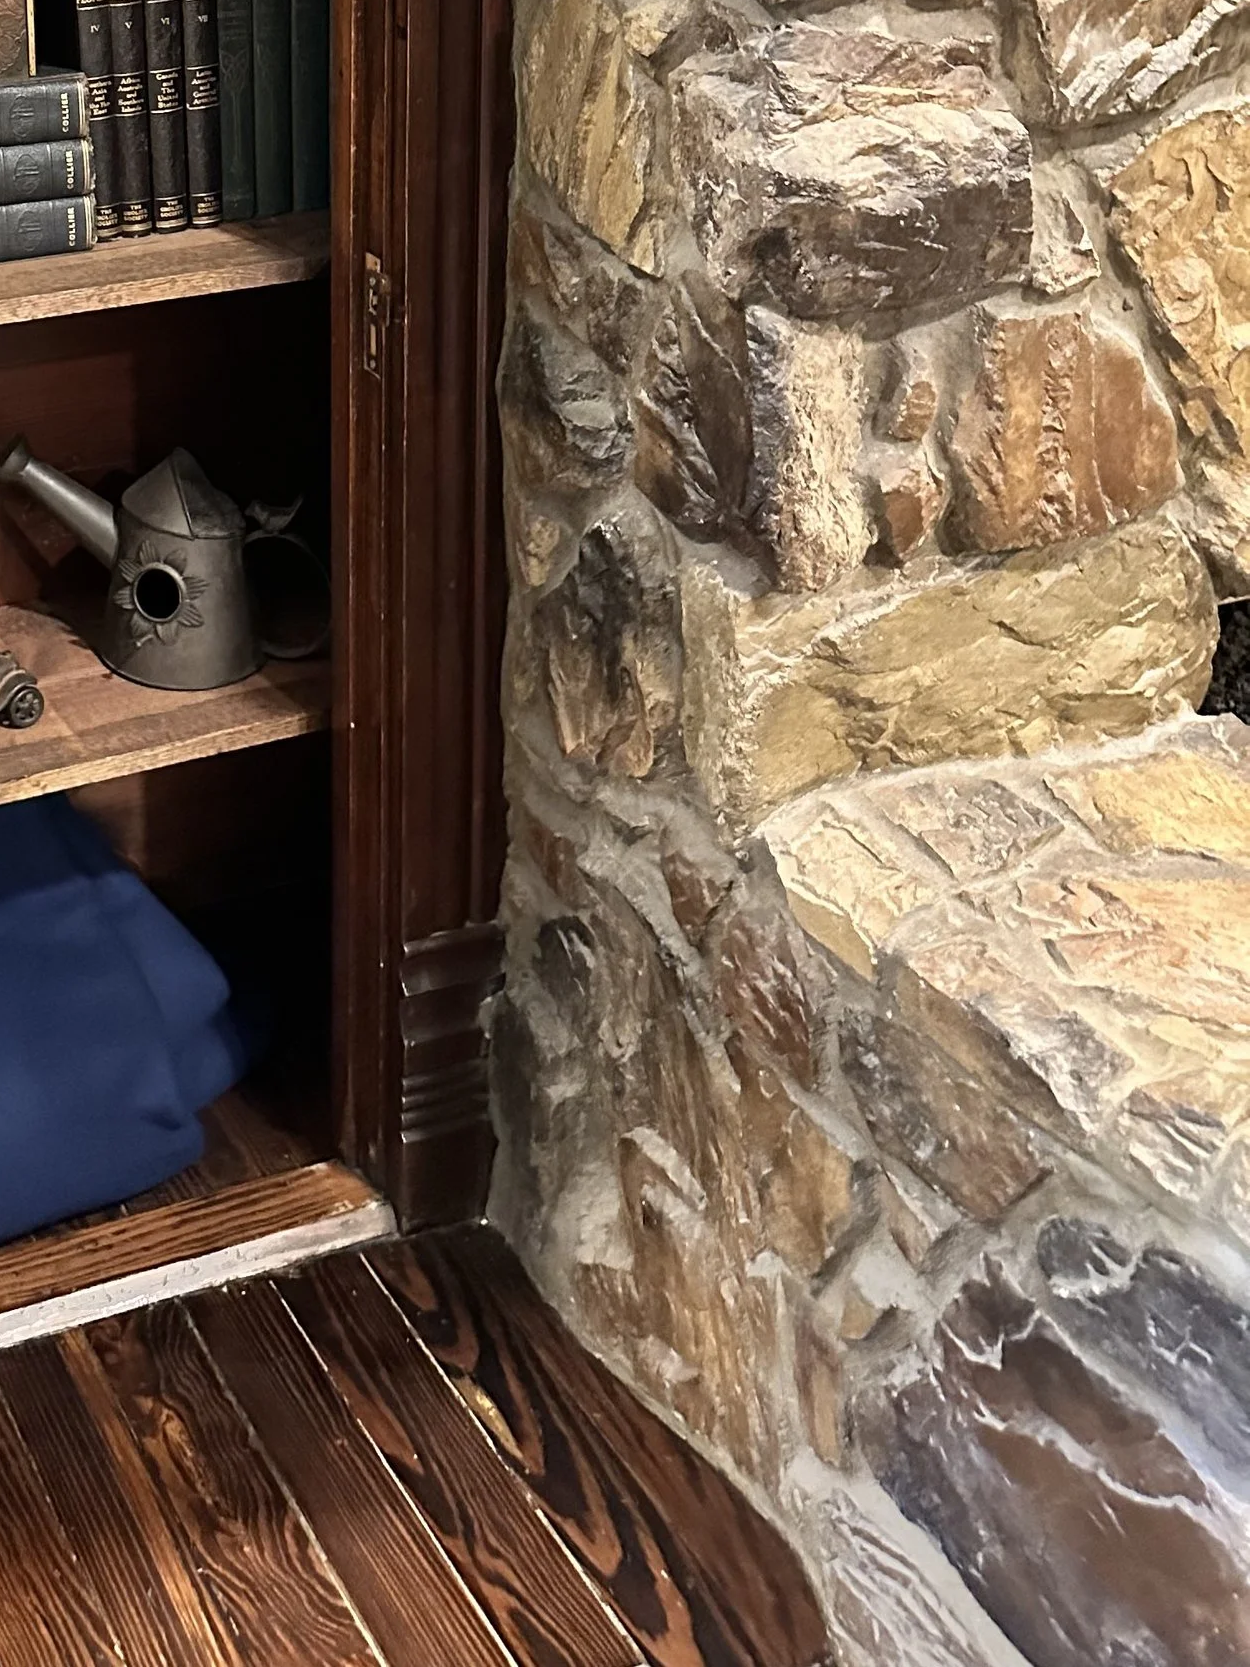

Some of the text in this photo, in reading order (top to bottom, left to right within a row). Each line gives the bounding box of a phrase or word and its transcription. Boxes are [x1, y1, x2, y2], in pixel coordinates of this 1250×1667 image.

[161, 17, 170, 25] VI
[198, 14, 208, 23] VII
[90, 24, 100, 33] IV
[125, 21, 132, 29] V
[155, 72, 179, 81] Canada
[162, 79, 173, 87] and
[157, 94, 179, 102] United
[60, 92, 70, 133] COLLIER
[65, 150, 75, 190] COLLIER
[66, 206, 77, 247] COLLIER
